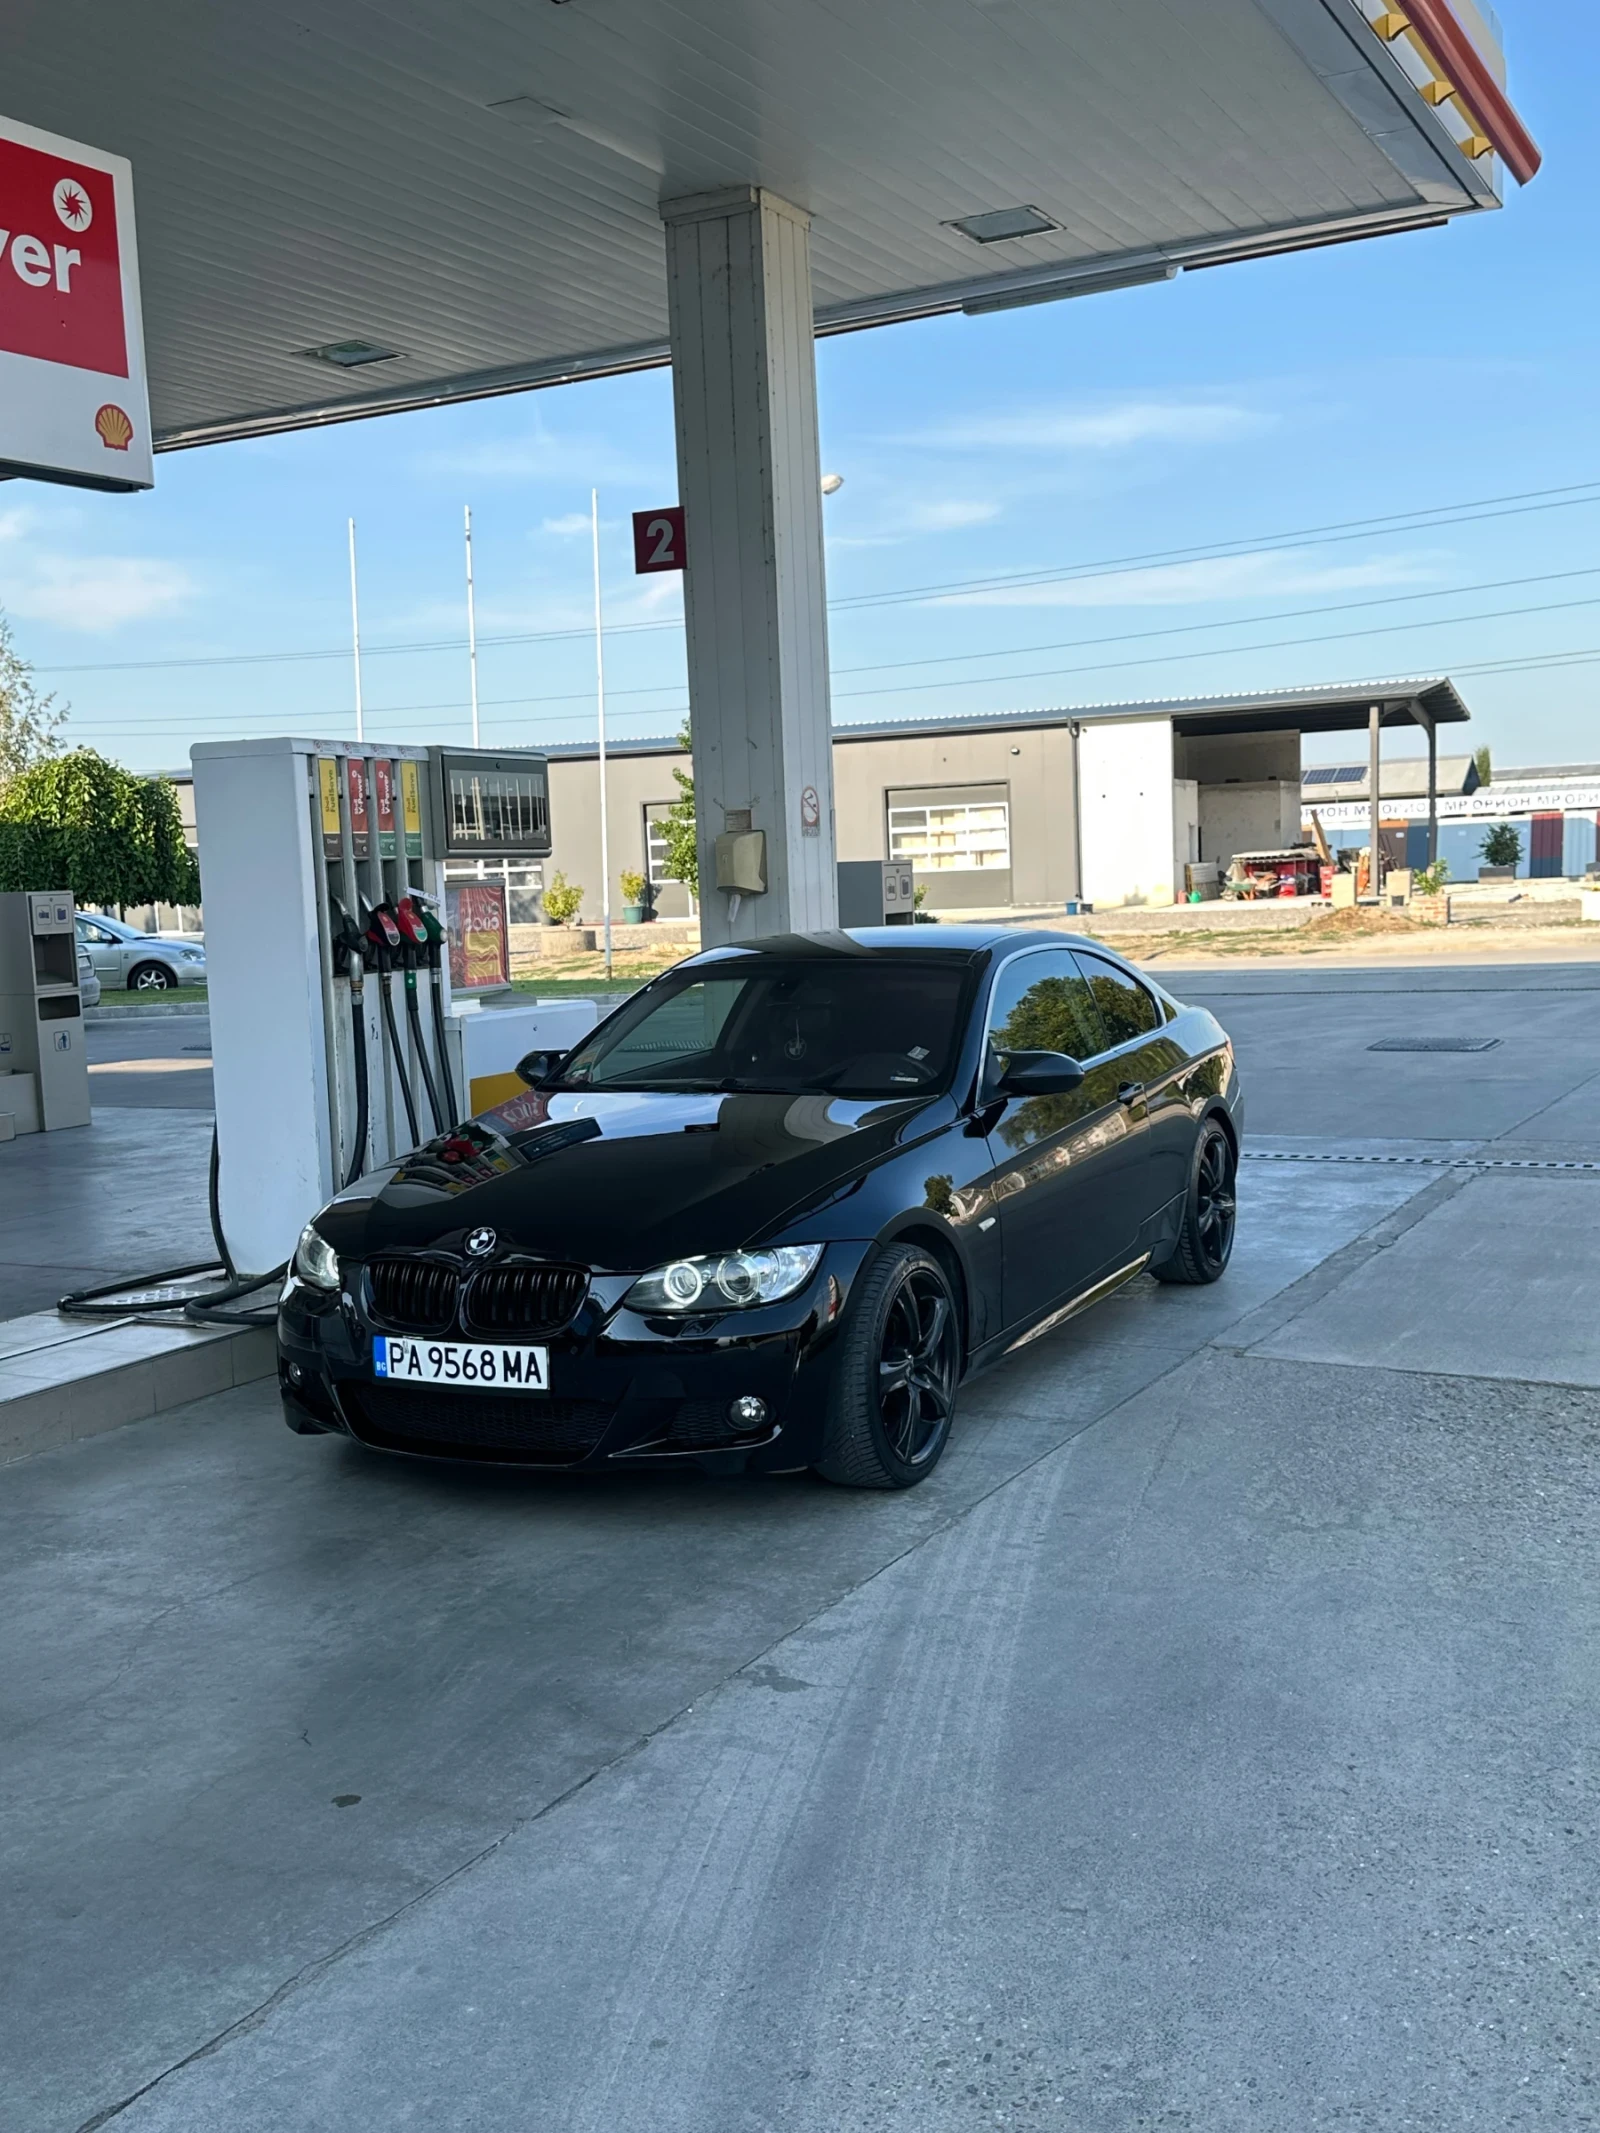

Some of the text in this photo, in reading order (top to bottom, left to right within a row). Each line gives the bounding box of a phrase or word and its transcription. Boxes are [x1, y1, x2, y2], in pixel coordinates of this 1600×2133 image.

[0, 228, 81, 294] er
[646, 518, 675, 564] 2
[328, 769, 336, 813] FuelSave
[1304, 806, 1348, 818] РИОН
[1472, 797, 1531, 810] ОРИОН
[376, 1360, 387, 1372] BG
[389, 1342, 542, 1384] PA 9568 MA
